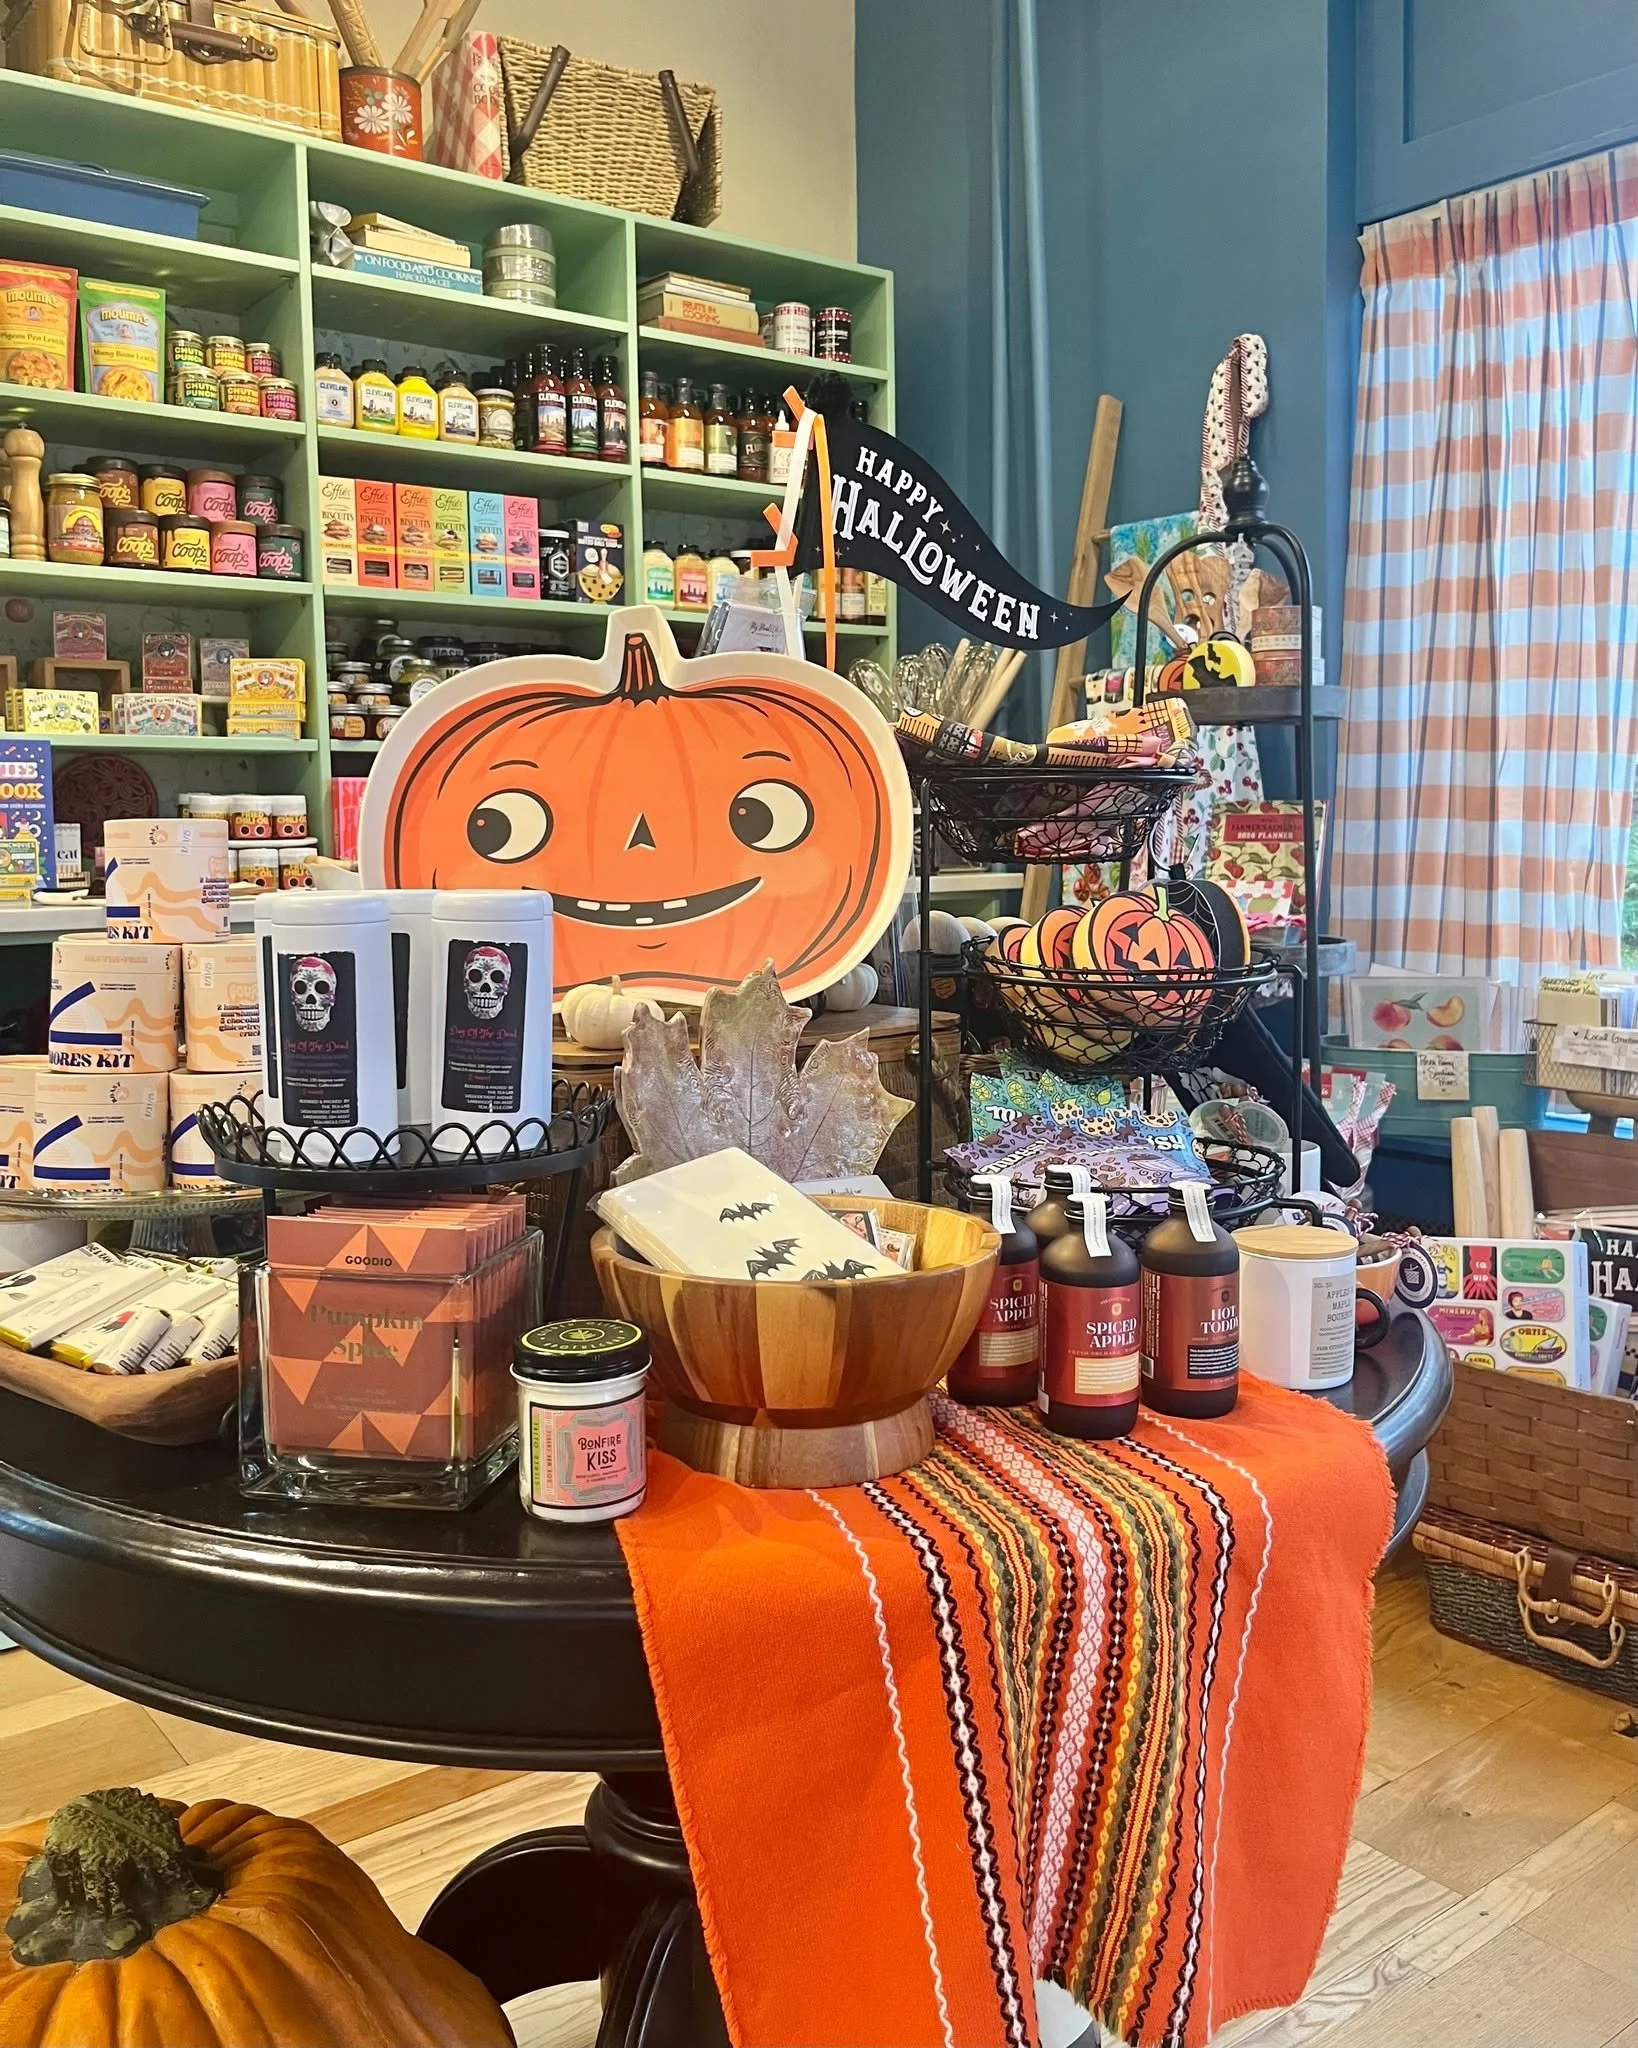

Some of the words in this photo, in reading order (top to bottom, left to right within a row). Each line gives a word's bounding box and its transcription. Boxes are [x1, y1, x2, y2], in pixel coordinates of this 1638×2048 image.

[365, 255, 381, 267] ON
[382, 257, 411, 273] FOOD
[410, 262, 434, 277] AND
[435, 266, 482, 285] COOKING
[395, 271, 425, 284] HAROLD
[682, 300, 707, 313] FRUITS
[707, 305, 717, 314] IN
[683, 310, 721, 325] COOKING
[856, 446, 944, 523] HAPPY
[321, 511, 354, 522] BISCUITS
[359, 514, 392, 527] BISCUITS
[400, 517, 431, 530] BISCUITS
[435, 520, 466, 532] BISCUITS
[473, 524, 503, 535] BISCUITS
[508, 528, 537, 540] BISCUITS
[117, 533, 154, 560] Coop's
[172, 535, 208, 568] Coop's
[214, 546, 249, 571] Coop's
[832, 474, 1040, 639] HALLOWEEN
[1257, 831, 1294, 839] PLANNER
[122, 926, 153, 939] KIT
[96, 1054, 135, 1068] KIT
[345, 1255, 393, 1268] GOODIO
[1326, 1287, 1350, 1300] APPLES
[989, 1293, 1036, 1310] SPICED
[310, 1304, 424, 1333] Pumpkin
[993, 1306, 1034, 1323] APPLE
[1211, 1305, 1237, 1321] HOT
[1439, 1307, 1477, 1316] MINERVA
[1086, 1317, 1137, 1335] SPICED
[1518, 1327, 1548, 1336] ORTIZ
[1089, 1331, 1135, 1348] APPLE
[334, 1339, 400, 1362] Spice
[577, 1434, 622, 1451] BONFIRE
[587, 1448, 617, 1472] KISS
